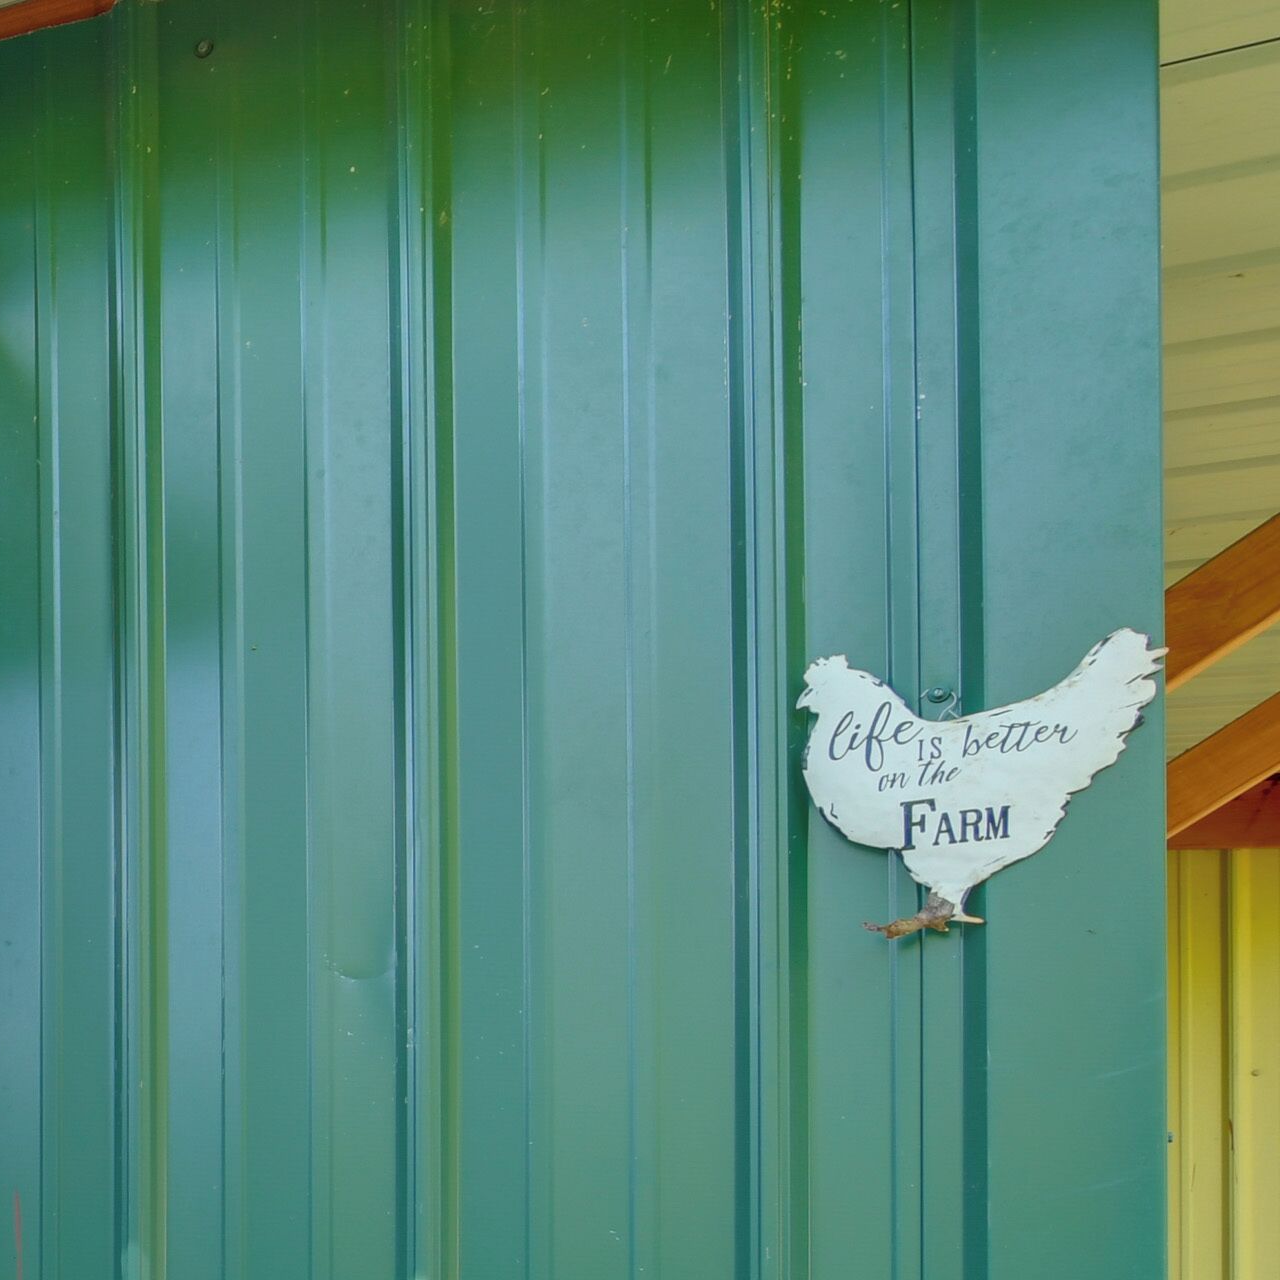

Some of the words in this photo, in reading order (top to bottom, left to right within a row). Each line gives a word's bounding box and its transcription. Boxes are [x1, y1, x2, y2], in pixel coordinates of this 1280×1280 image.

[829, 701, 924, 772] life
[962, 720, 1079, 757] better
[878, 772, 912, 792] on
[917, 759, 962, 787] the
[900, 798, 1011, 850] FARM
